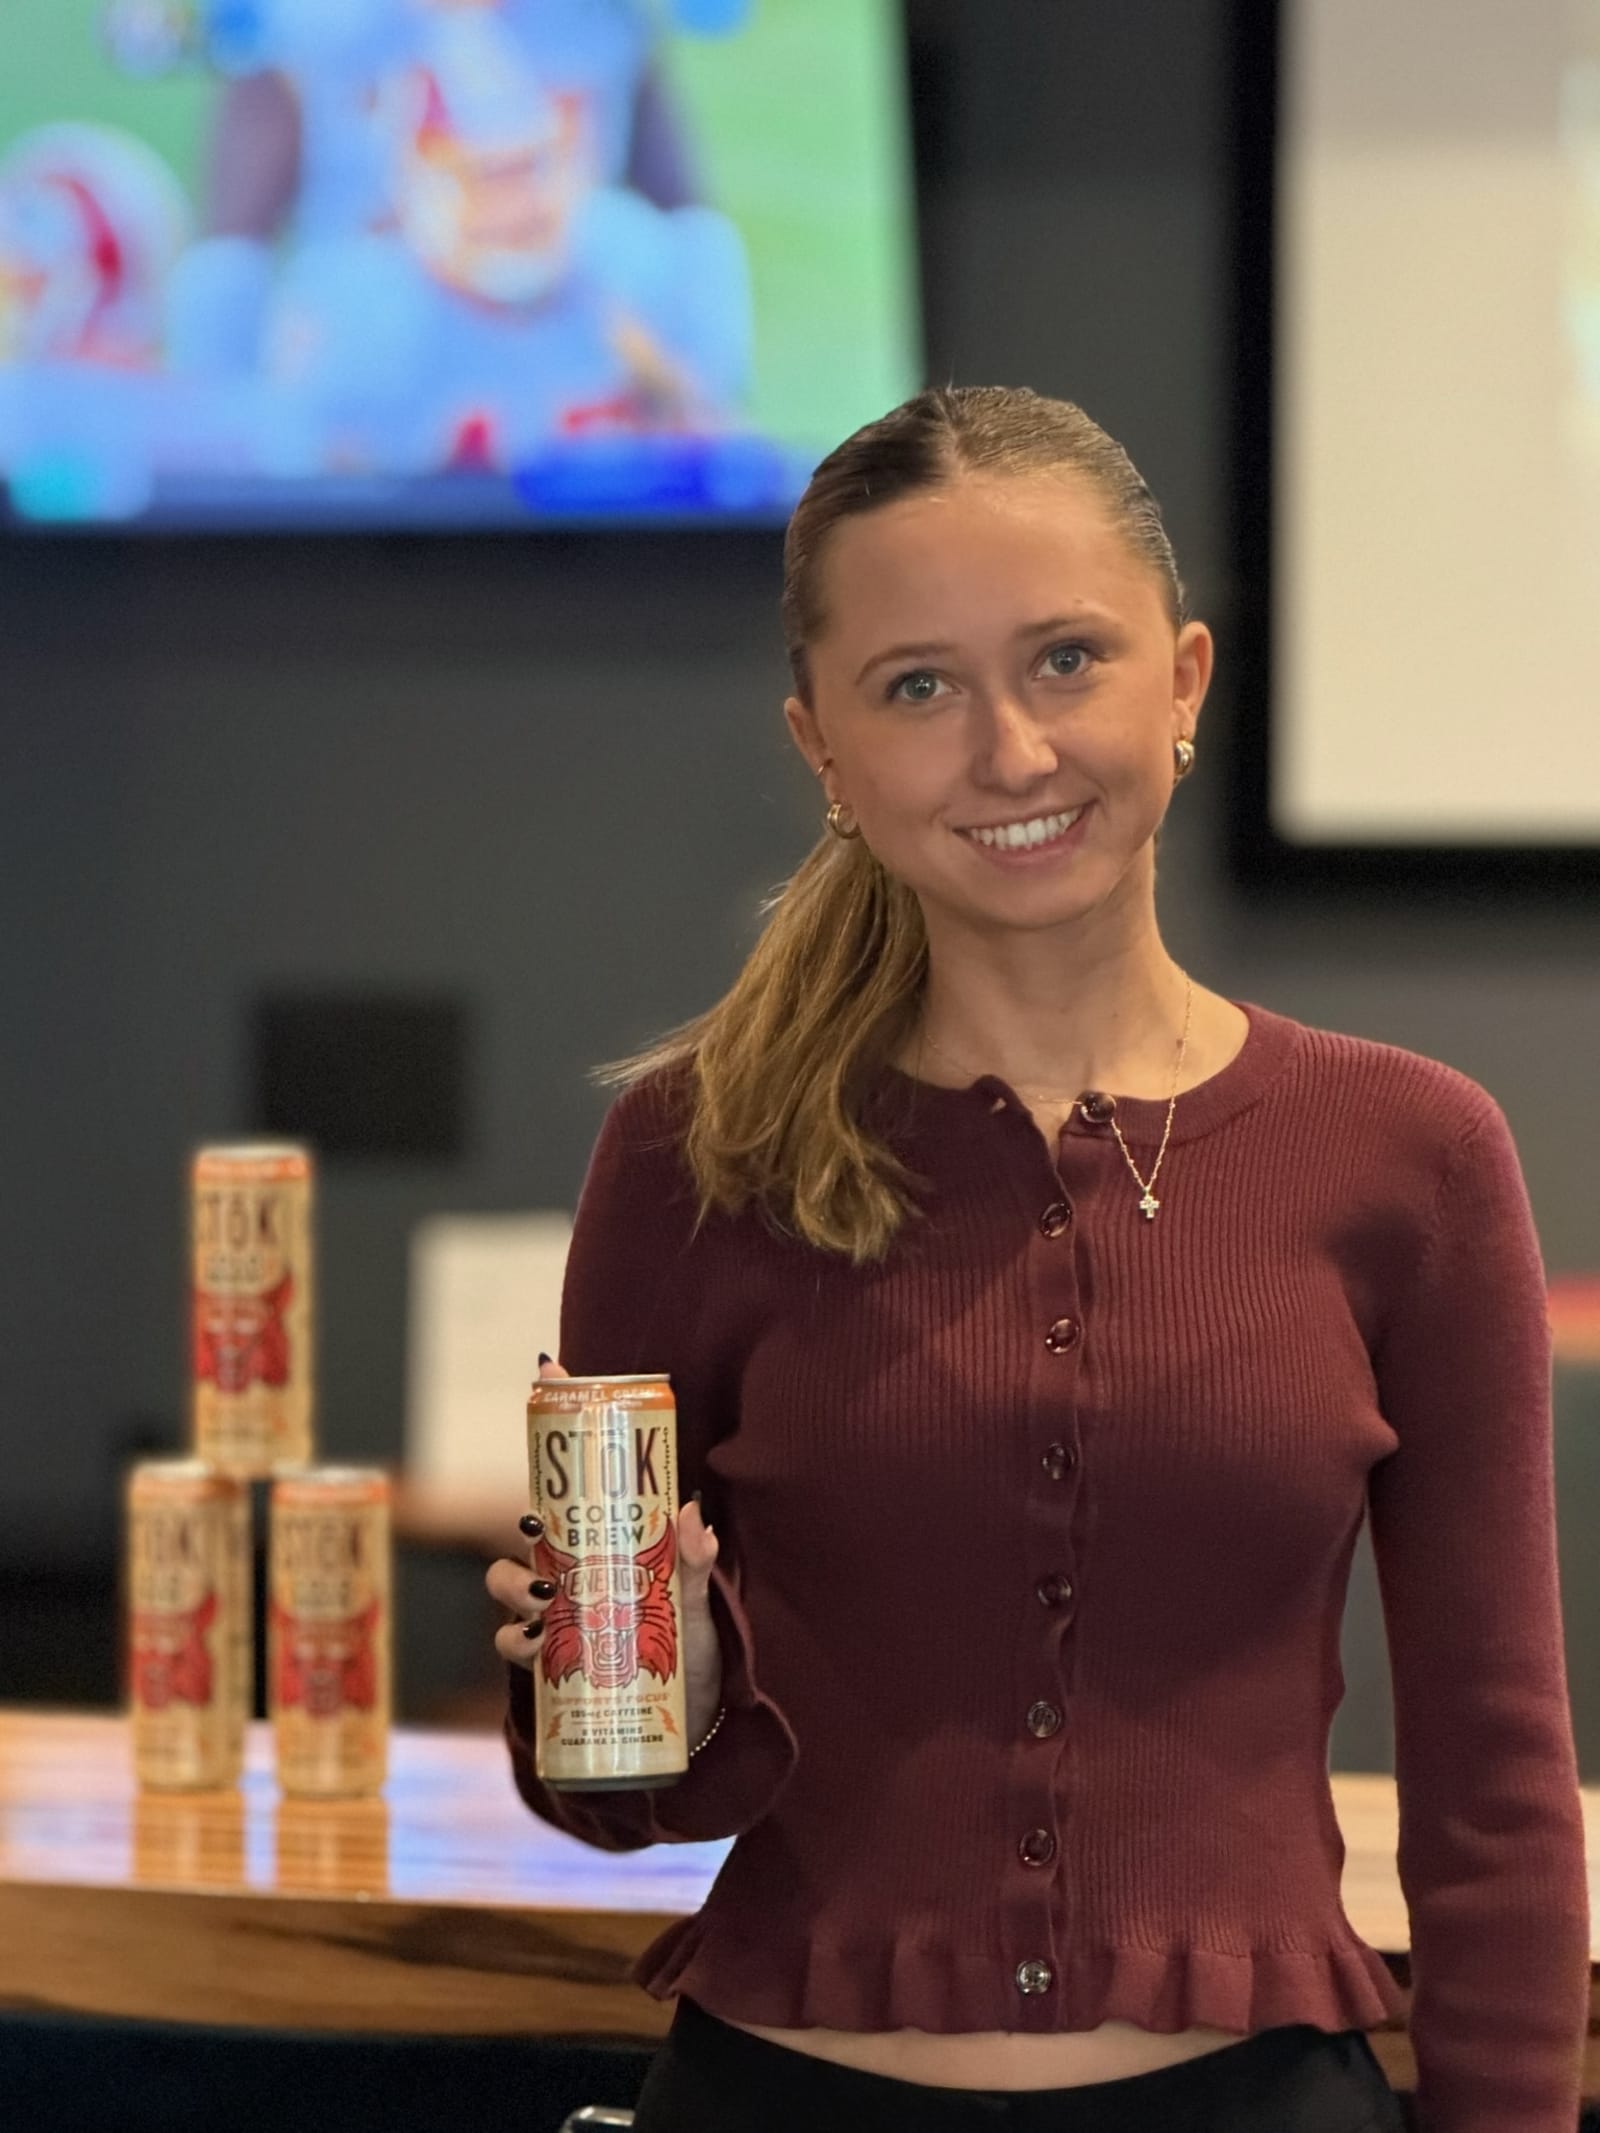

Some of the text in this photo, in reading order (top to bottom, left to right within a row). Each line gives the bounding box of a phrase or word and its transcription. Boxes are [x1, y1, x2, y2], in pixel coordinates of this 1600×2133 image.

[566, 1503, 643, 1524] COLD
[567, 1525, 644, 1547] BREW
[592, 1726, 642, 1736] VITAMINS
